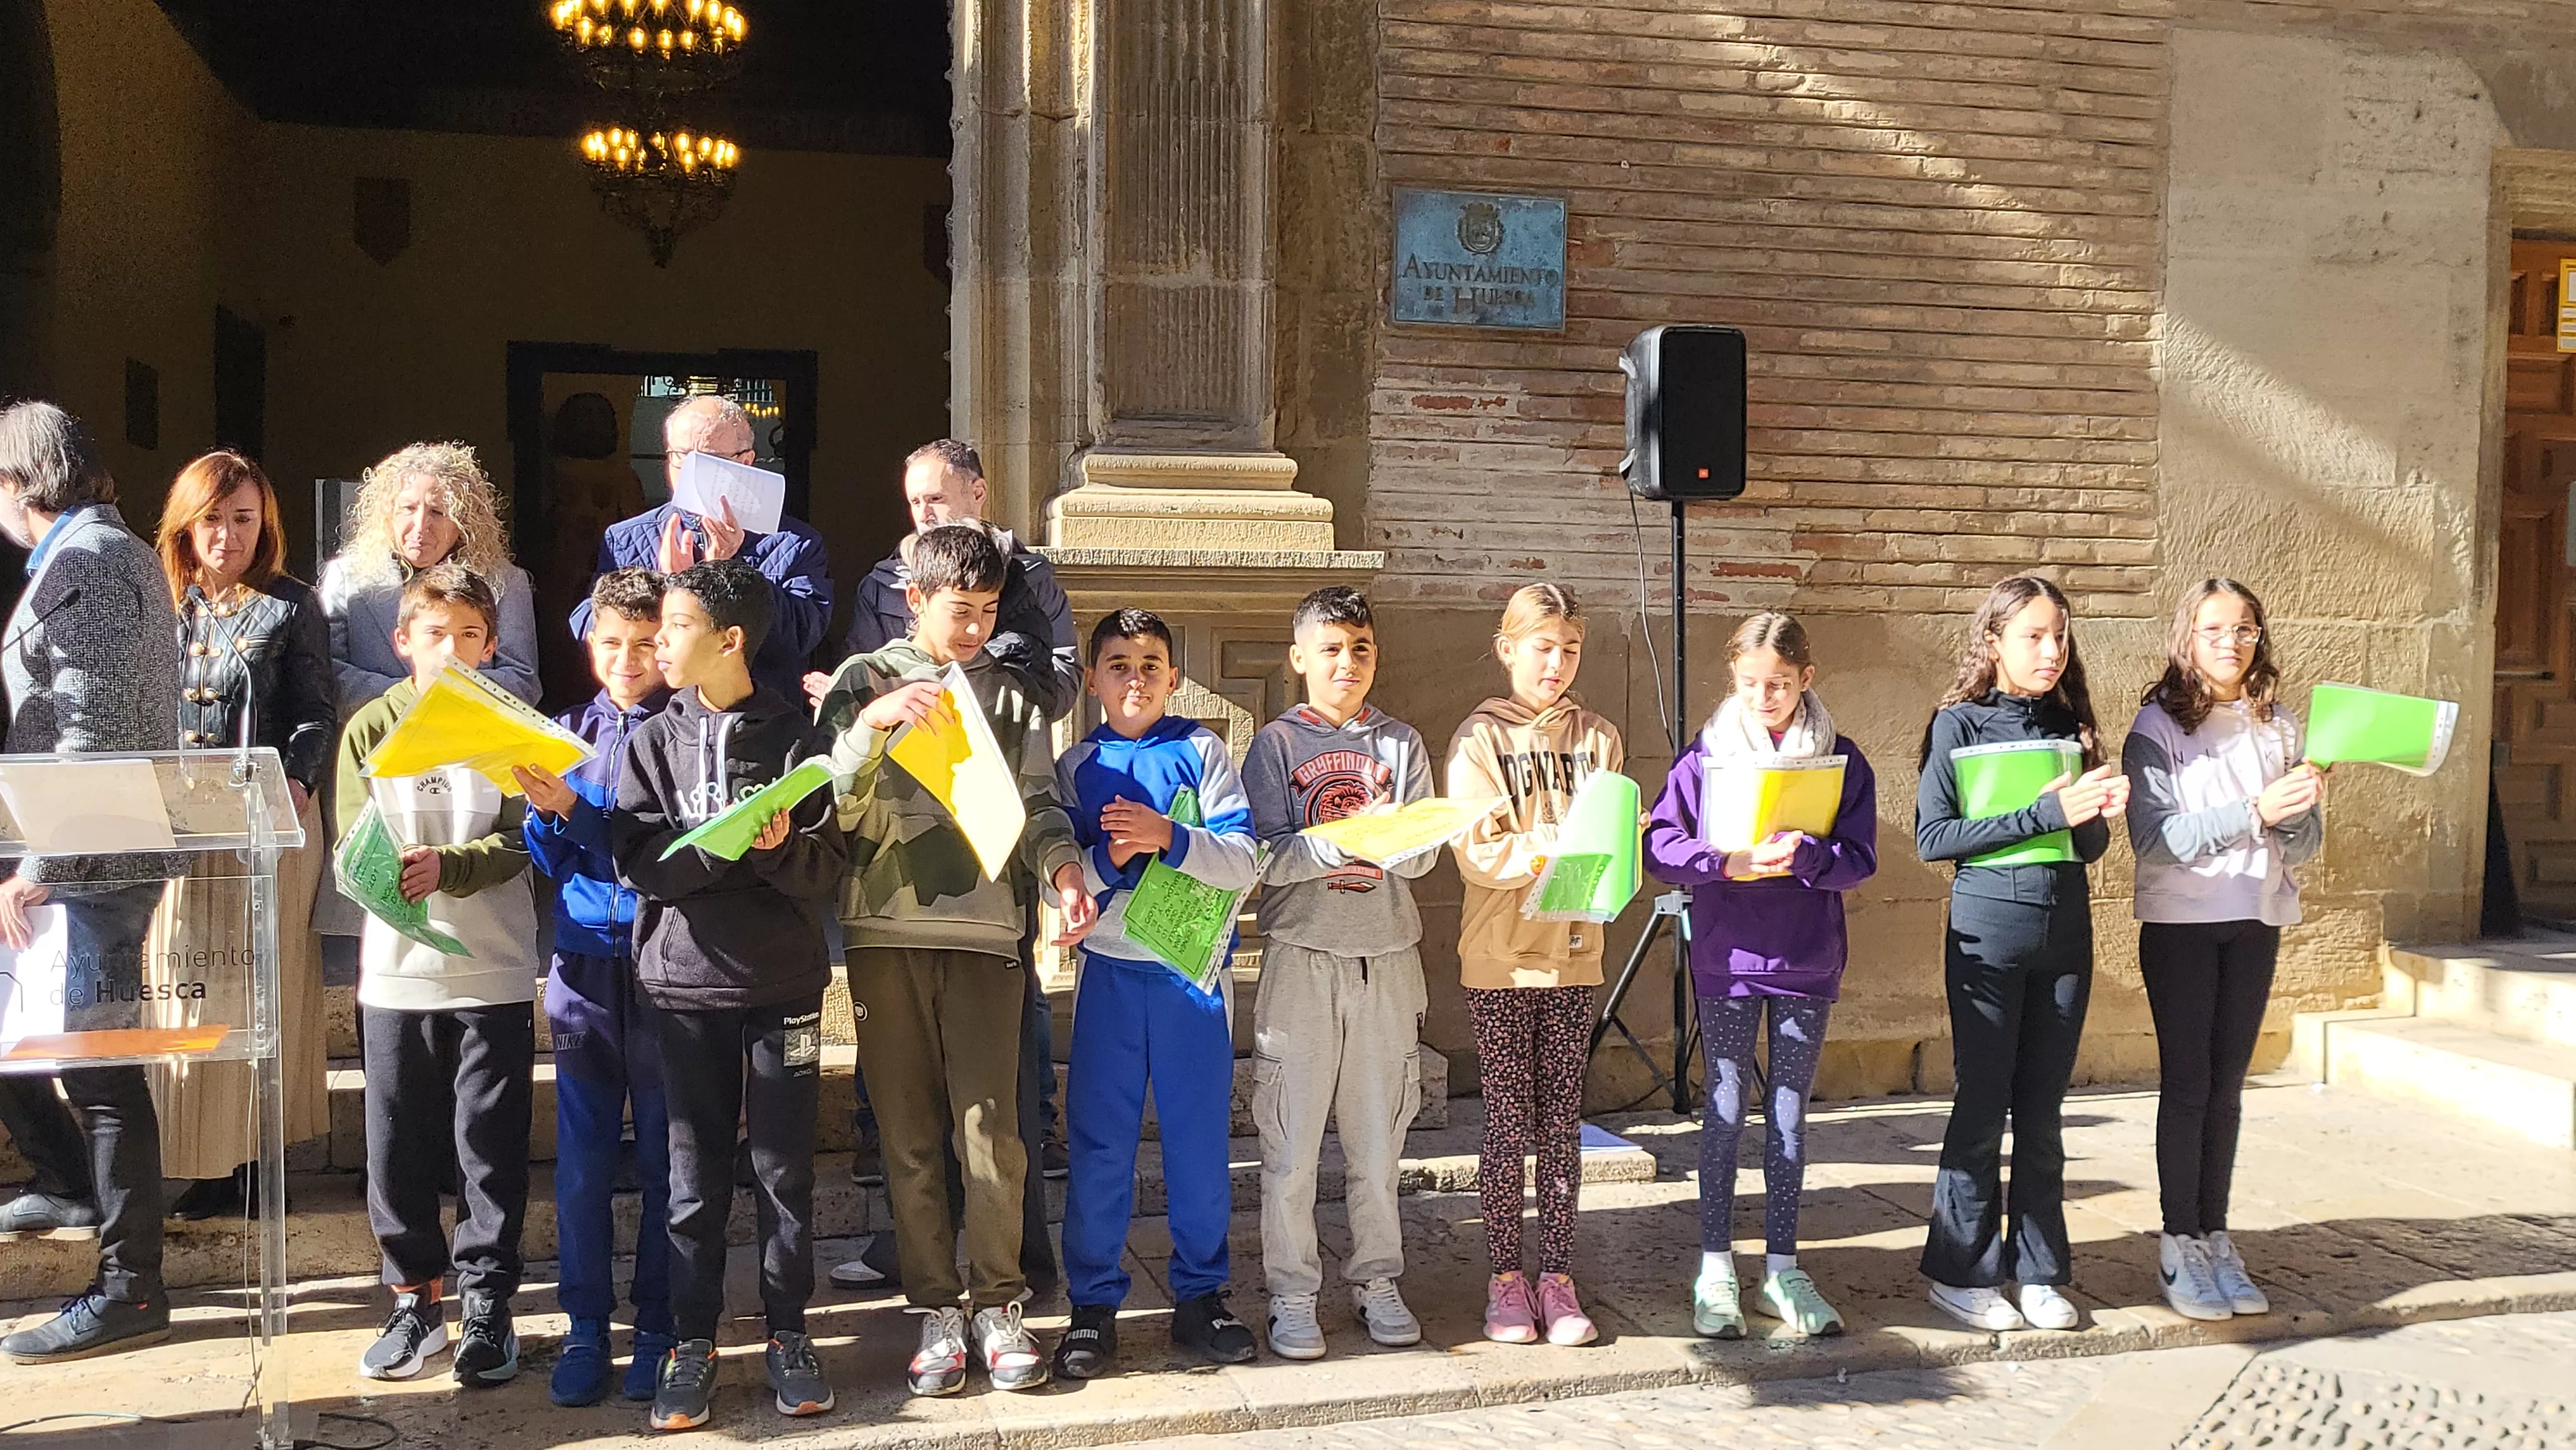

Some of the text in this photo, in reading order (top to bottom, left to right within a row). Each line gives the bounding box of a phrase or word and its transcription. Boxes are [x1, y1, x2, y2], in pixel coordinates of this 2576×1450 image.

[1401, 253, 1559, 288] AYUNTAMIENTO
[50, 979, 207, 1006] de Huesca
[784, 1012, 820, 1026] PlayStation
[556, 1031, 586, 1050] NIKE
